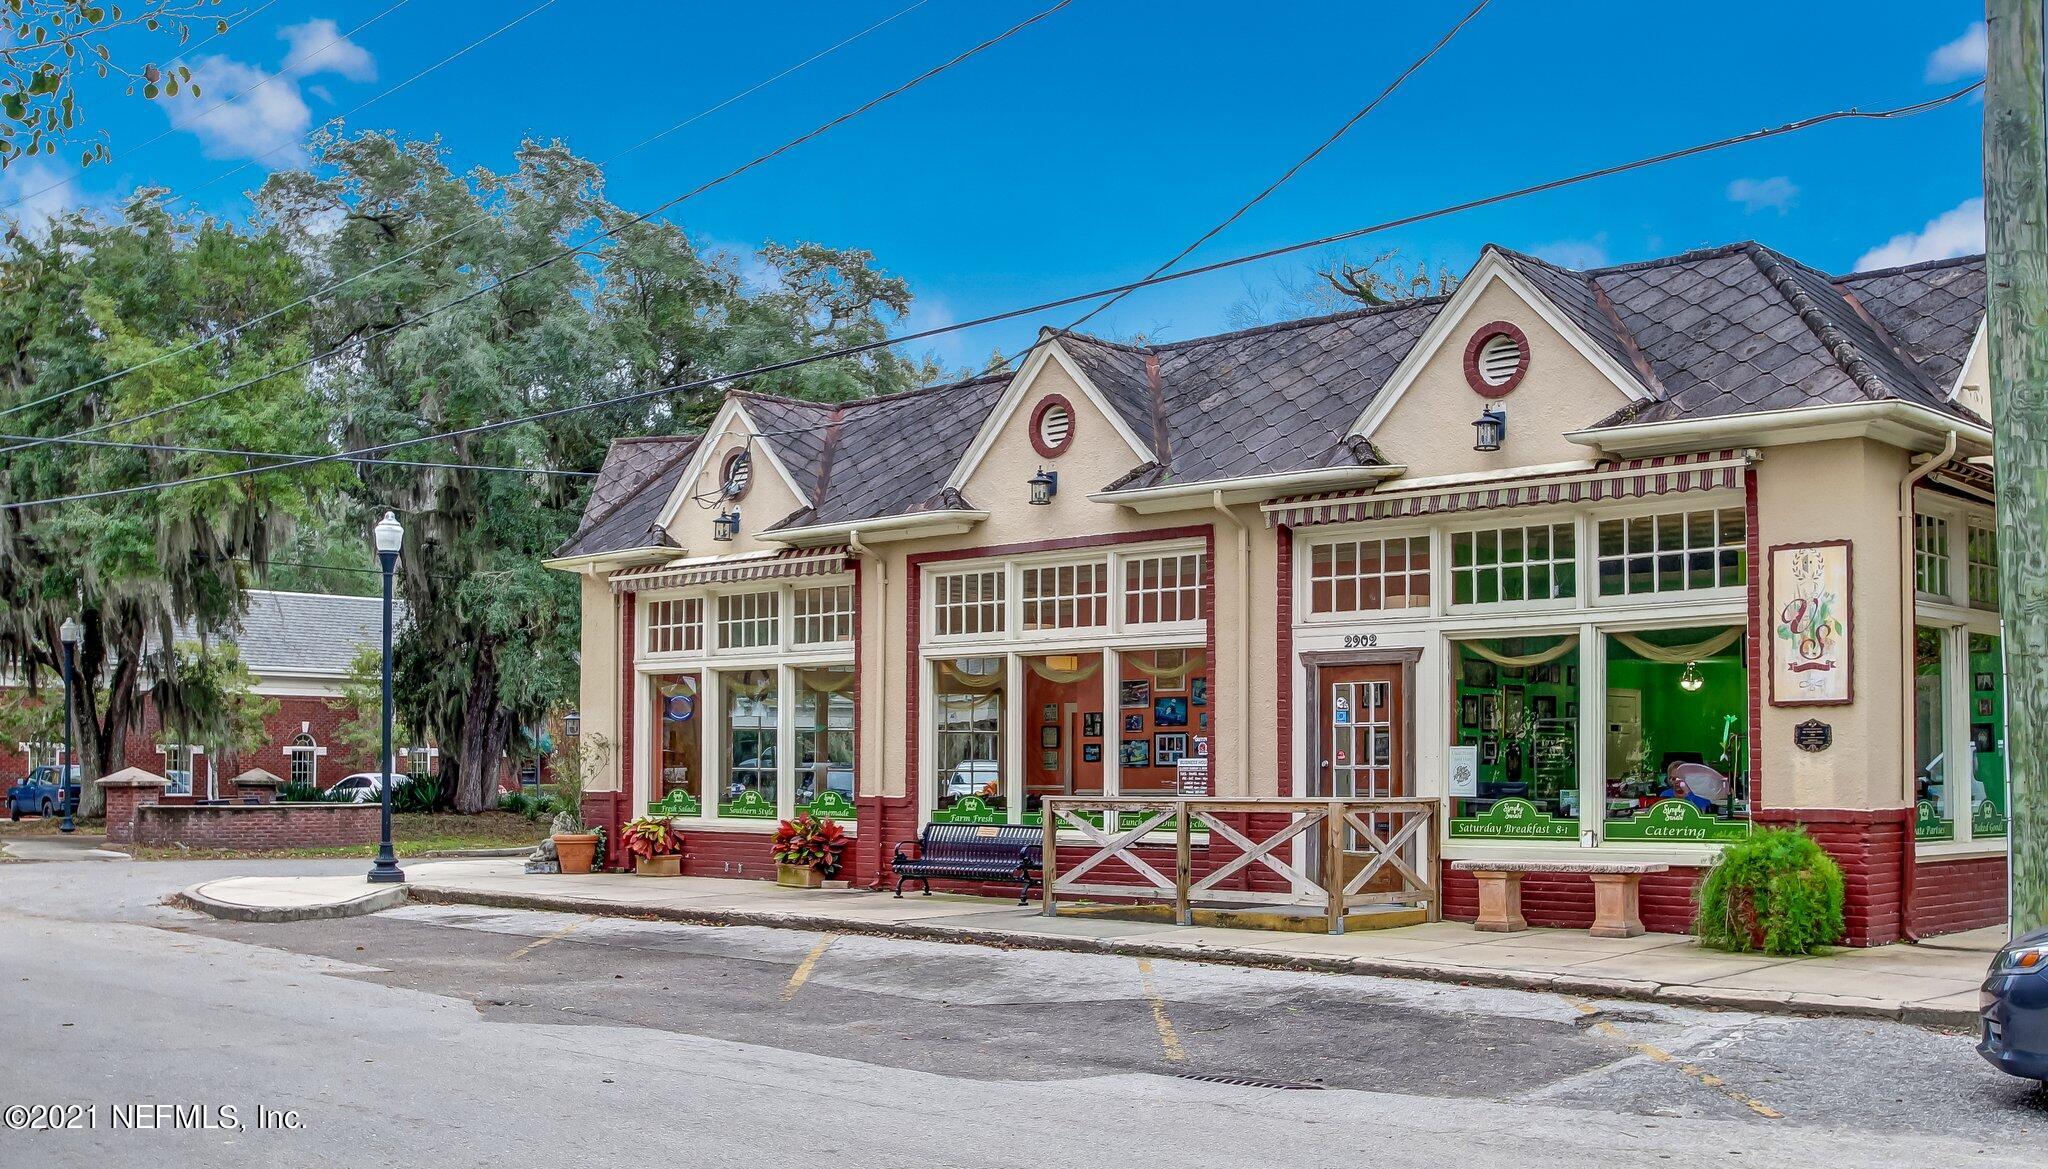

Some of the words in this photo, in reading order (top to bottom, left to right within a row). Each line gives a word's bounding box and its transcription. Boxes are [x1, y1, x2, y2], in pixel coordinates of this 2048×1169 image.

[1344, 634, 1377, 647] 2902
[661, 804, 677, 813] Fresh
[678, 804, 697, 813] Salads
[729, 806, 757, 814] Southern
[758, 806, 774, 816] Style
[810, 808, 850, 816] Homemade
[950, 813, 971, 823] Farm
[972, 812, 993, 824] Fresh
[1459, 823, 1502, 836] Saturday
[1504, 823, 1550, 836] Breakfast
[1645, 825, 1706, 839] Catering
[1989, 821, 2004, 833] Goods
